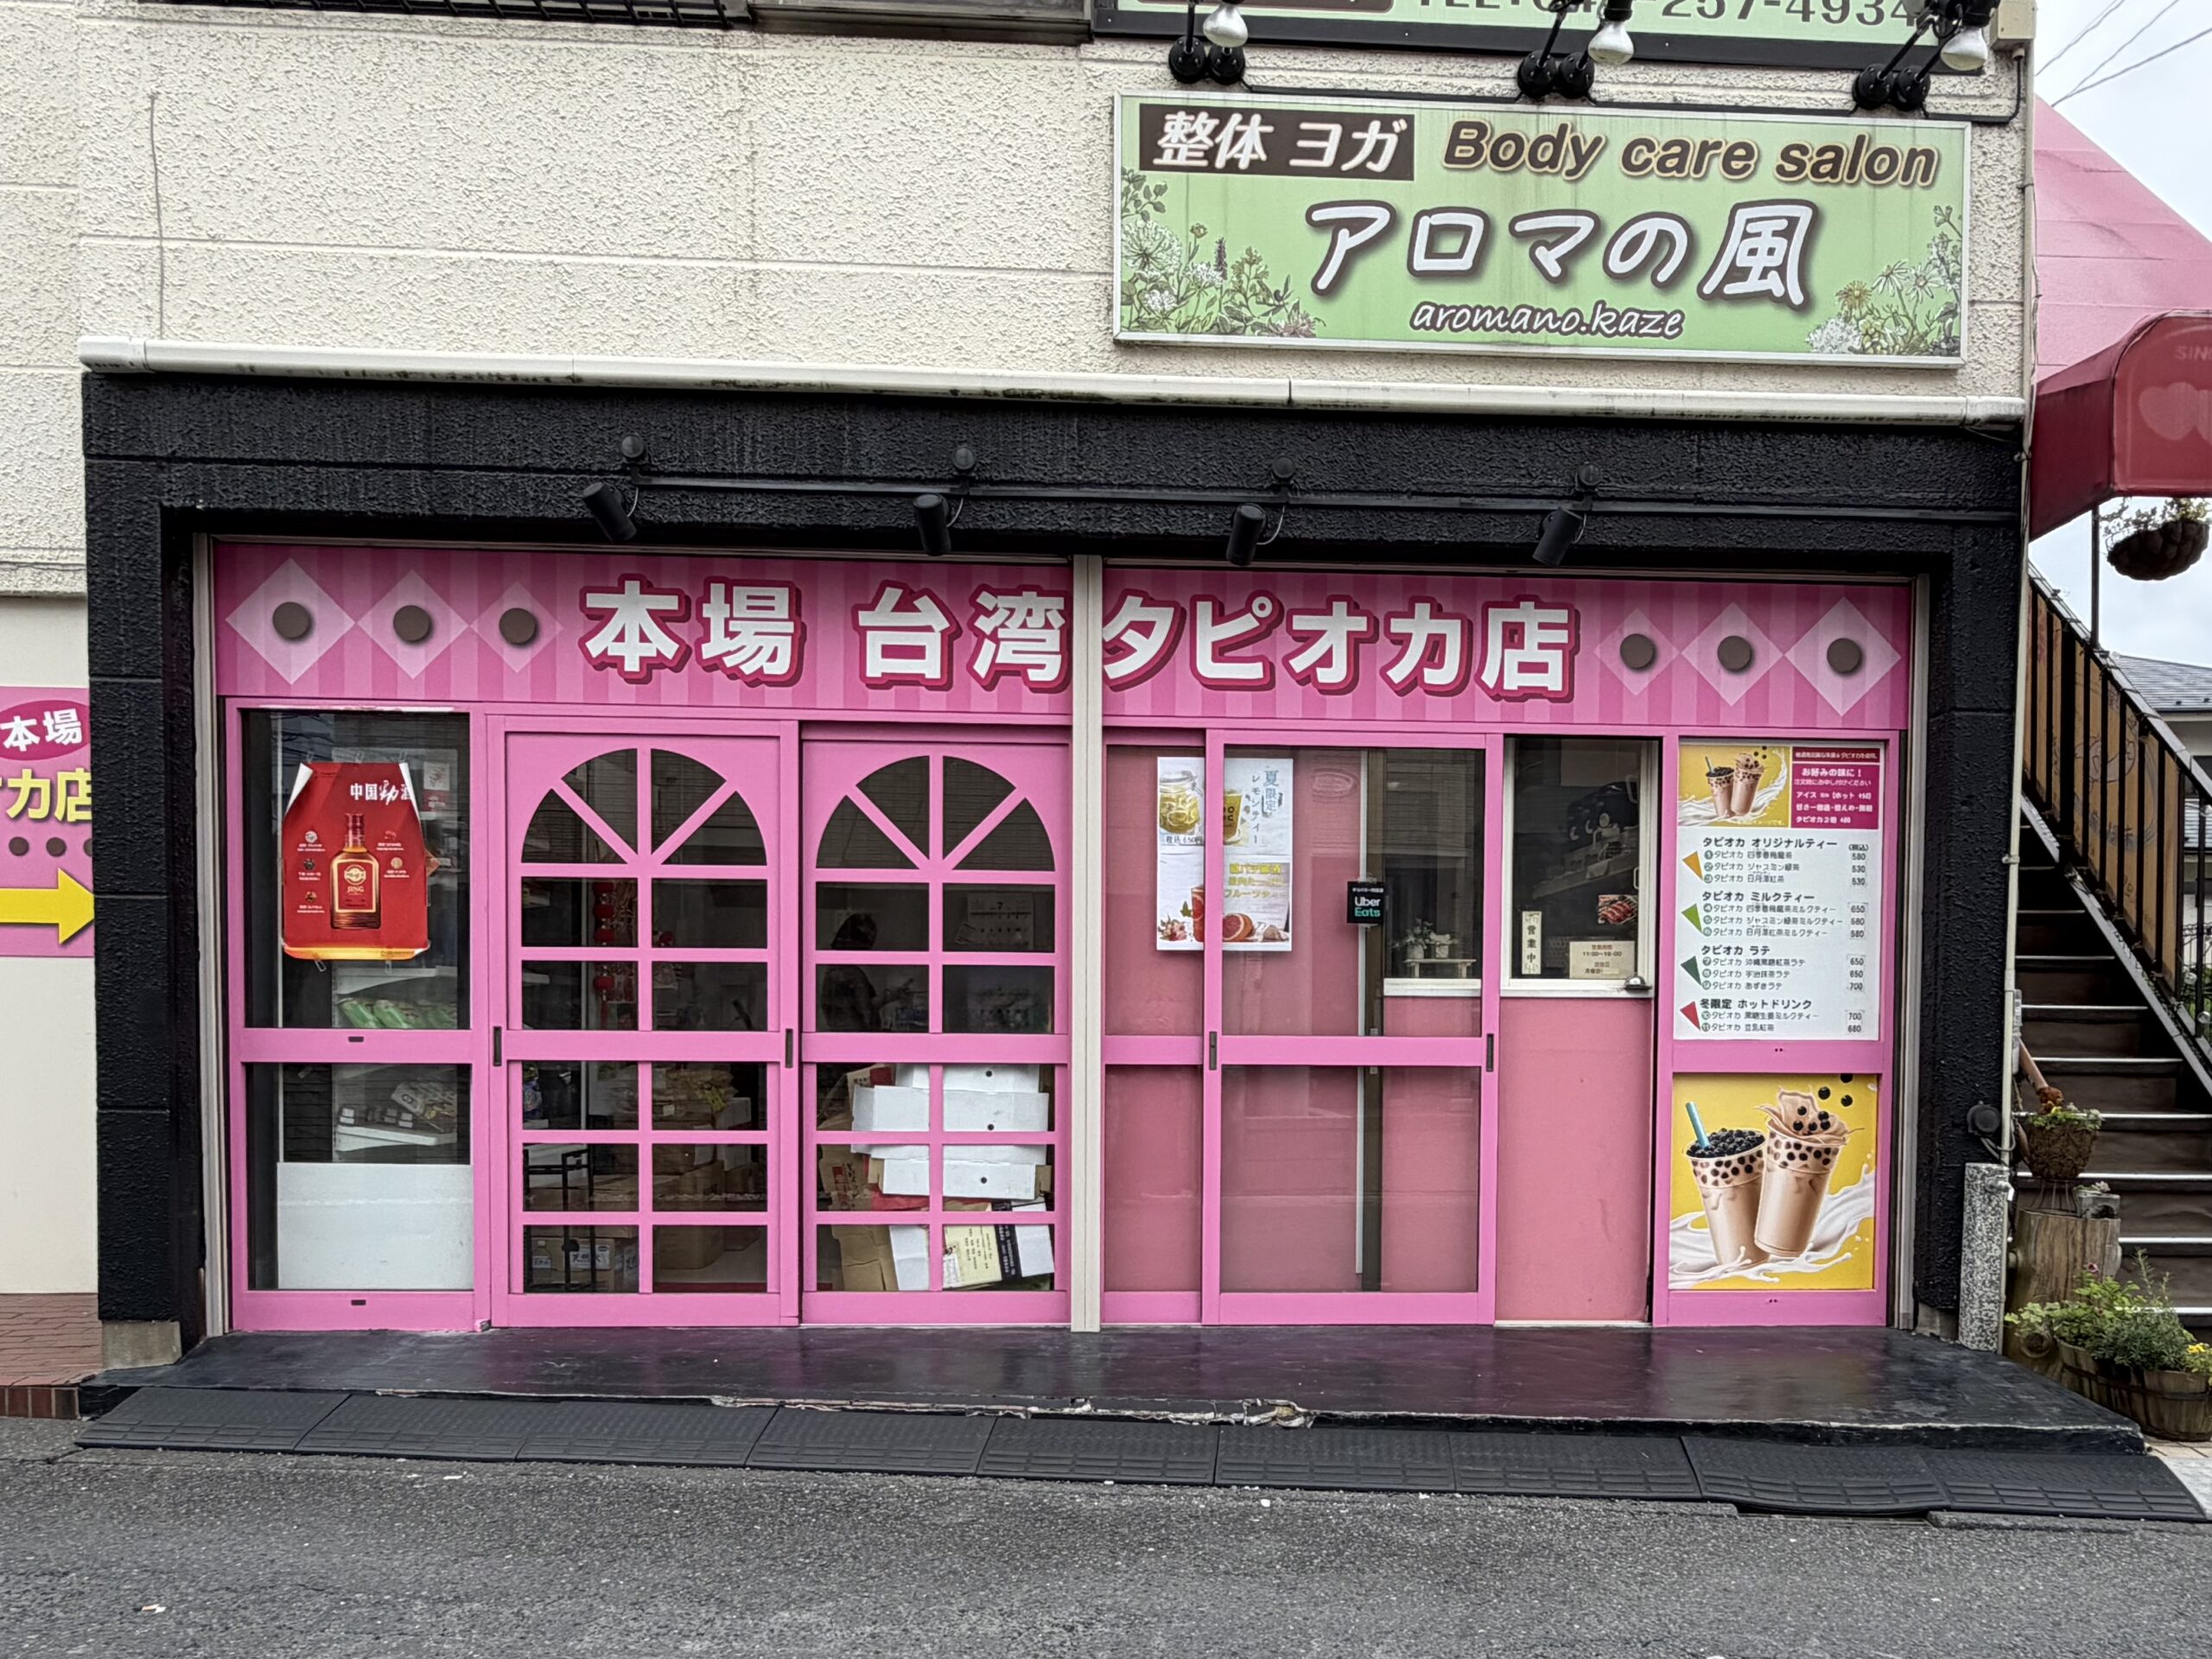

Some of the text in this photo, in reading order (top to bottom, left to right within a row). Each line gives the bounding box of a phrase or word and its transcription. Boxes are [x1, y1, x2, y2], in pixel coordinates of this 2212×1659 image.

[1152, 110, 1408, 173] 整体 ヨガ
[1441, 119, 1941, 187] Body care salon
[1306, 200, 1817, 312] アロマの風
[1410, 300, 1686, 339] aromano.kaze
[582, 577, 799, 683] 本場
[0, 709, 83, 752] 本場
[0, 767, 92, 822] カ店
[1251, 775, 1261, 844] レモンティー
[1702, 836, 1745, 848] タピオカ
[1751, 837, 1838, 849] オリジナルティー
[1355, 897, 1381, 906] Uber
[1355, 907, 1381, 917] Eats
[1702, 891, 1815, 902] タピオカ ミルクティー
[1527, 925, 1536, 963] 営業中
[1701, 945, 1770, 956] タピオカ ラテ
[1700, 999, 1812, 1009] 冬限定 ホットドリンク
